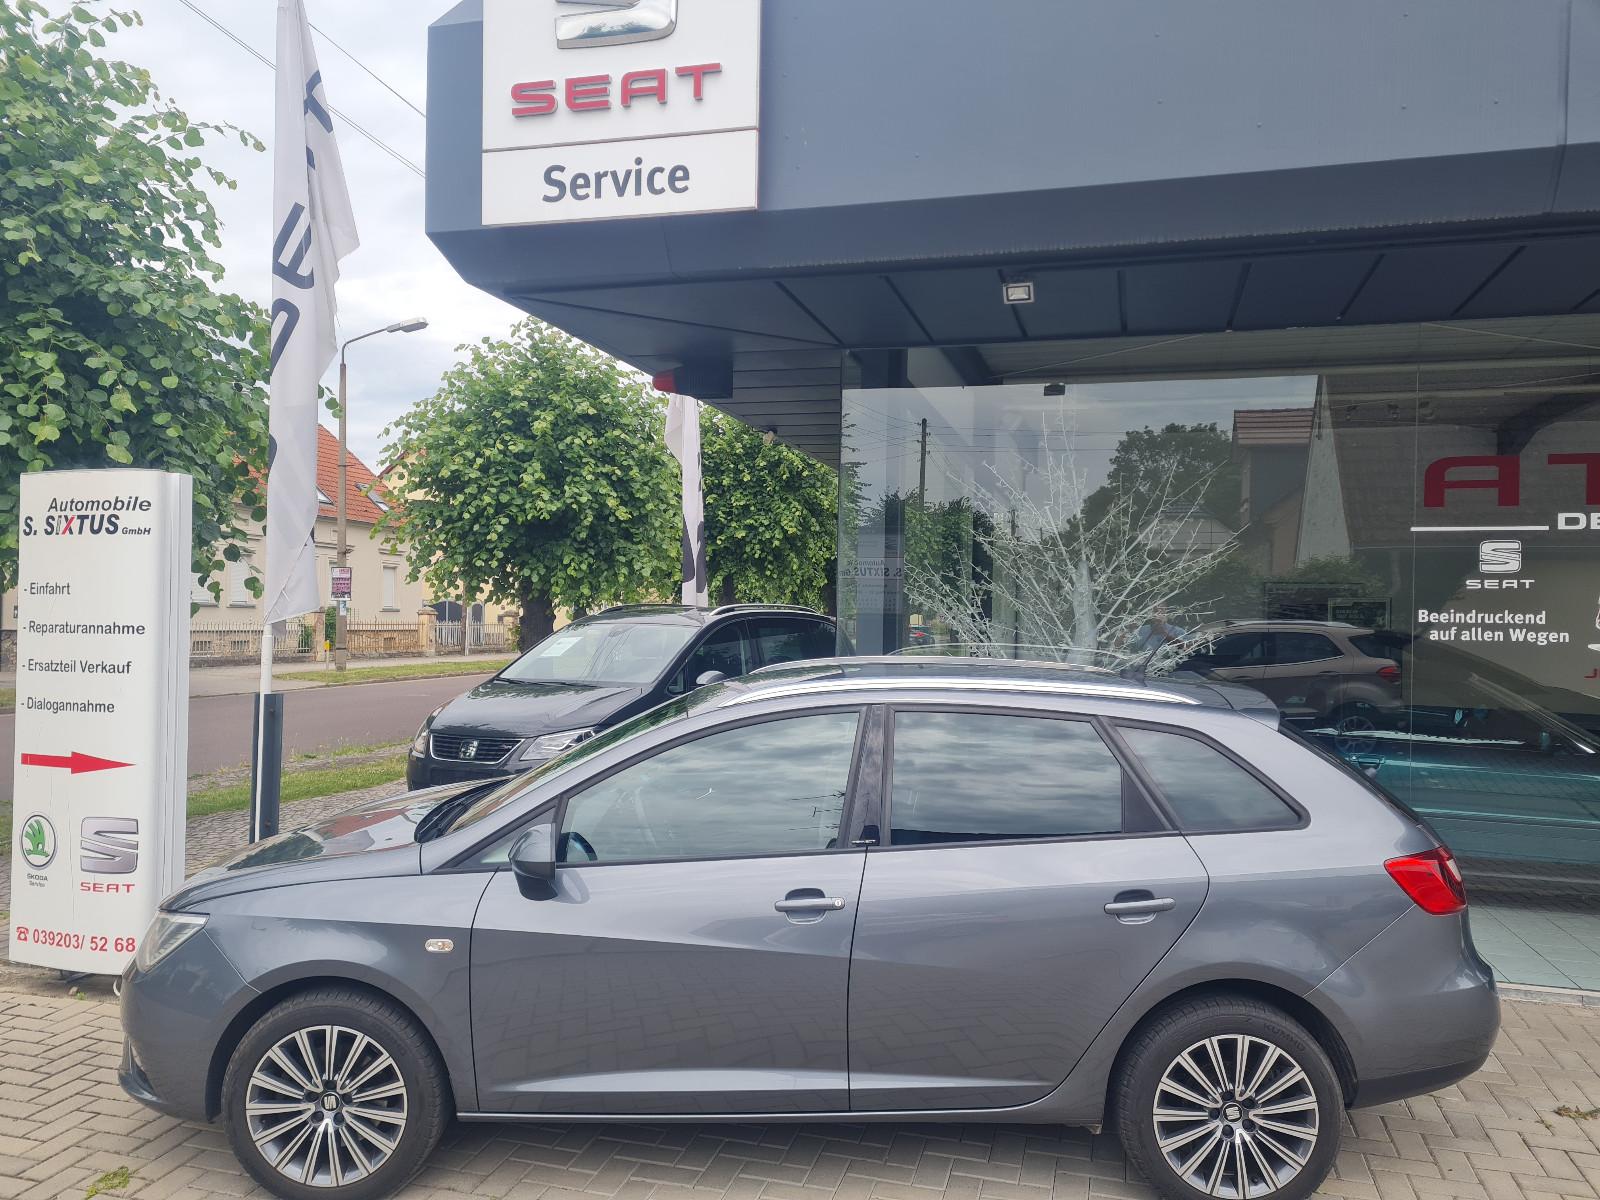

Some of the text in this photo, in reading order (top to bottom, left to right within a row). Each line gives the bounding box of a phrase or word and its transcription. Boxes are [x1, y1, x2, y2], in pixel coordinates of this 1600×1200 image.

[511, 62, 722, 117] SEAT
[542, 156, 690, 203] Service
[48, 496, 152, 513] Automobile
[23, 515, 38, 537] S.
[121, 526, 152, 536] GmbH
[1465, 579, 1535, 589] SEAT
[1418, 609, 1546, 625] Beeindruckend
[1429, 627, 1570, 646] auf allen Wegen
[80, 660, 132, 675] Verkauf
[80, 881, 136, 894] SEAT
[33, 929, 136, 953] 039203/ 52 68
